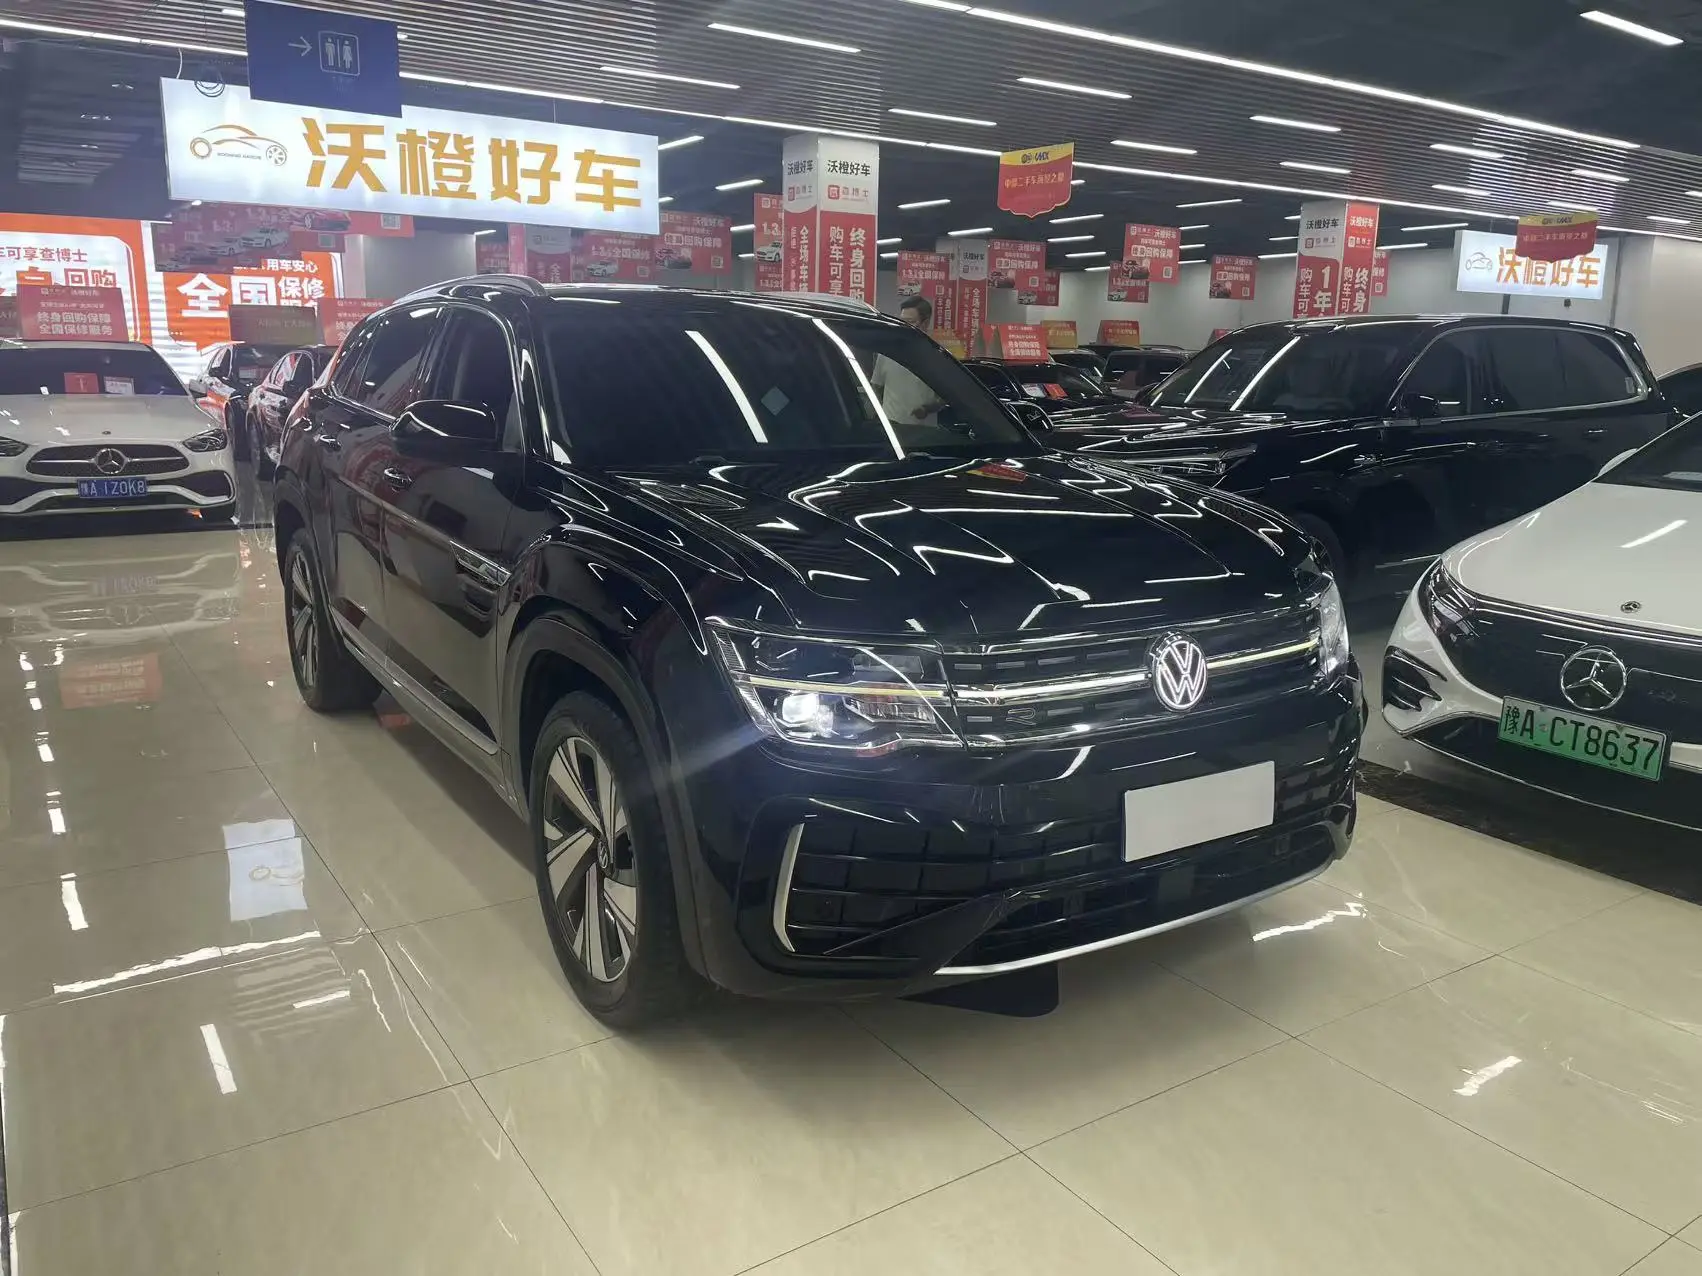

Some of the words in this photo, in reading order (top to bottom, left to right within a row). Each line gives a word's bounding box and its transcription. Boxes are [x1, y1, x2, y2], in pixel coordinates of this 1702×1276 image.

[301, 117, 641, 212] 沃橙好车
[827, 159, 871, 176] 沃橙好车
[0, 246, 88, 263] 可享查博士
[829, 226, 844, 297] 购车可享
[177, 273, 277, 318] 全国
[278, 276, 325, 299] 保修
[1353, 267, 1369, 313] 终身
